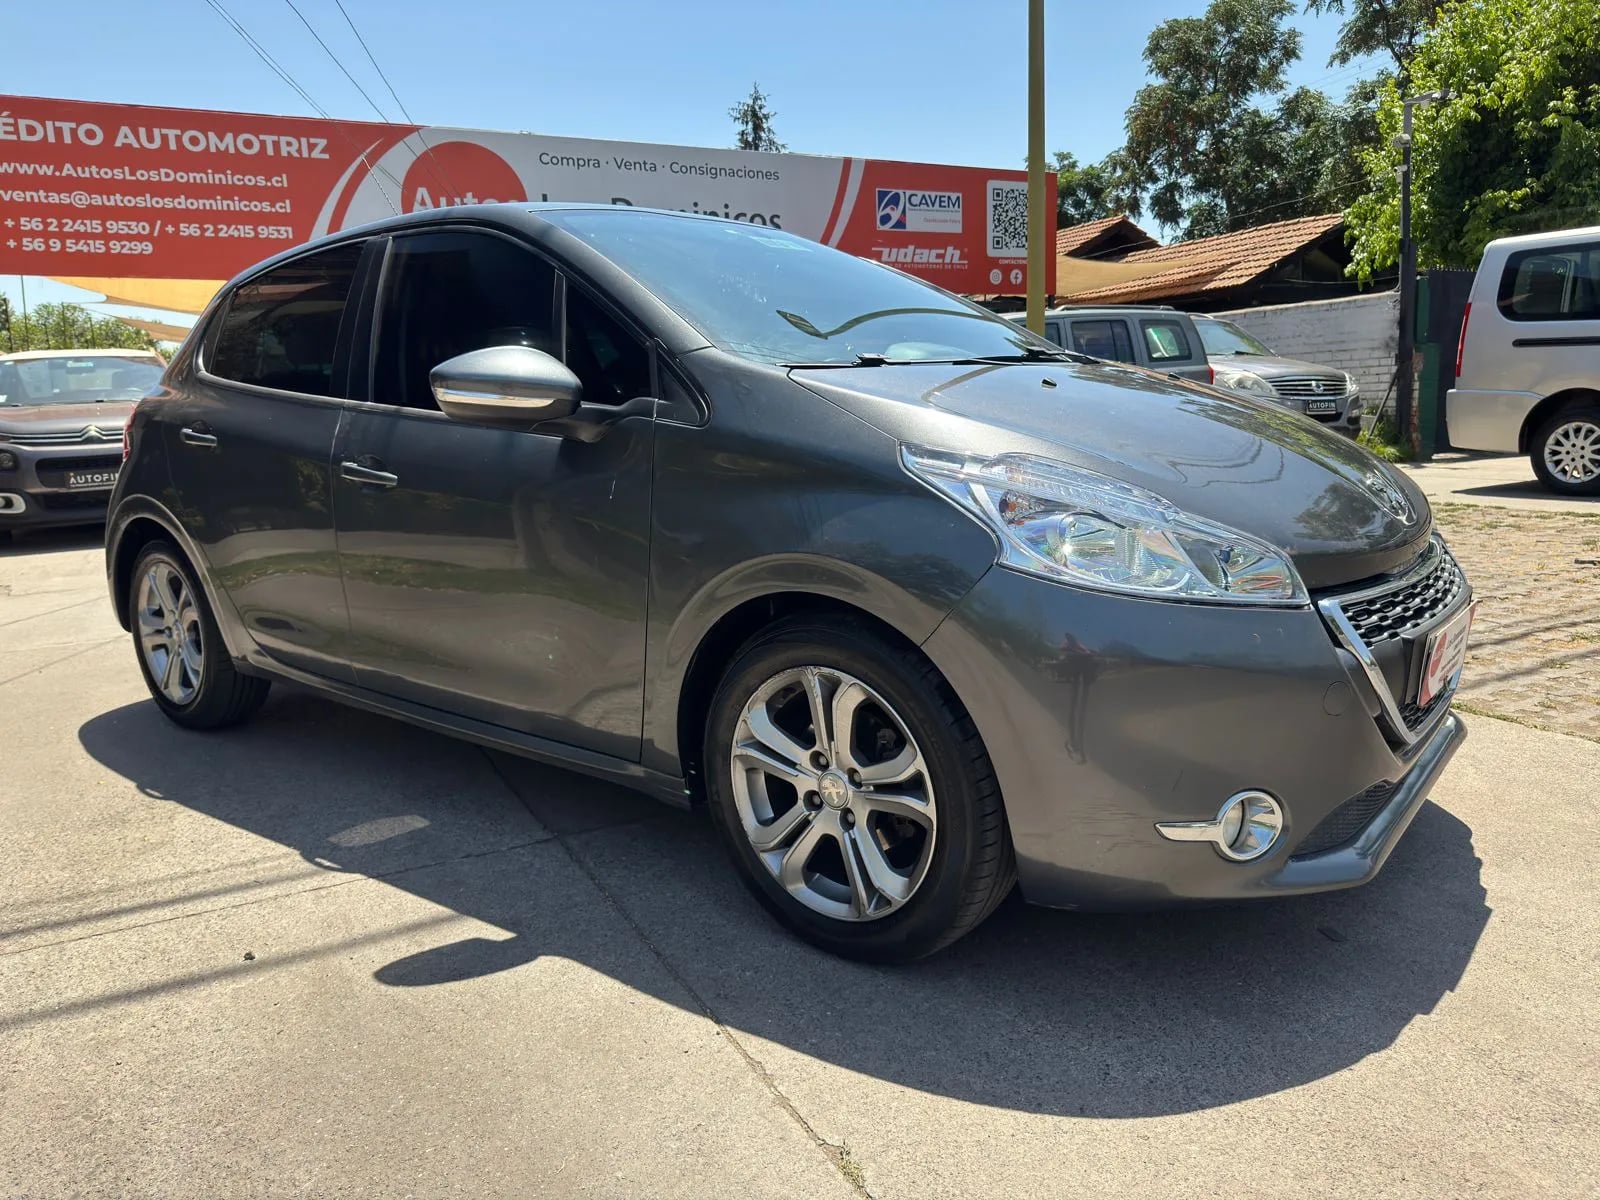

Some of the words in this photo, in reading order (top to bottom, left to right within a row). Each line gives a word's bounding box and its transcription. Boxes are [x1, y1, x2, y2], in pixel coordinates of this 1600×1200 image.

[0, 112, 104, 146] ÉDITO
[114, 126, 330, 159] AUTOMOTRIZ
[0, 162, 288, 187] www.AutosLosDominicos.cl
[539, 152, 601, 170] Compra
[613, 157, 657, 173] Venta
[670, 161, 780, 181] Consignaciones
[0, 189, 291, 213] ventas@autoslosdominicos.cl
[908, 193, 960, 209] CAVEM
[20, 217, 43, 231] 56
[47, 218, 59, 232] 2
[62, 218, 103, 233] 2415
[106, 220, 150, 235] 9530
[179, 223, 201, 237] 56
[204, 224, 215, 237] 2
[218, 224, 254, 238] 2415
[258, 226, 293, 239] 9531
[22, 237, 46, 251] 56
[49, 238, 61, 252] 9
[66, 239, 106, 253] 5415
[109, 240, 153, 255] 9299
